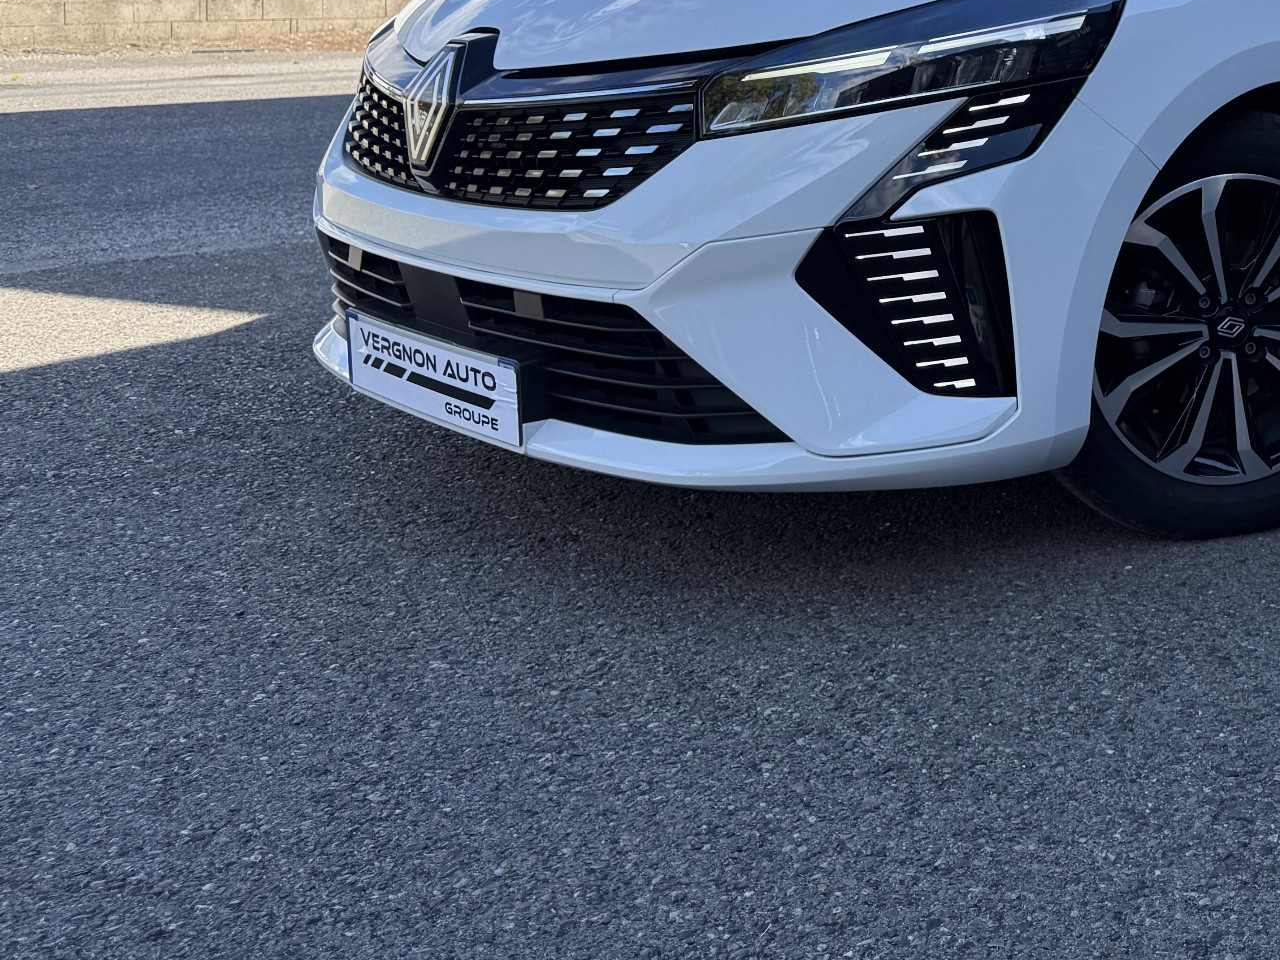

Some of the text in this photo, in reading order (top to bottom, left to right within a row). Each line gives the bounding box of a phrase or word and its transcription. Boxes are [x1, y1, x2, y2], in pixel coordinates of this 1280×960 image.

[360, 328, 497, 391] VERGNON AUTO
[445, 401, 499, 431] GROUPE
